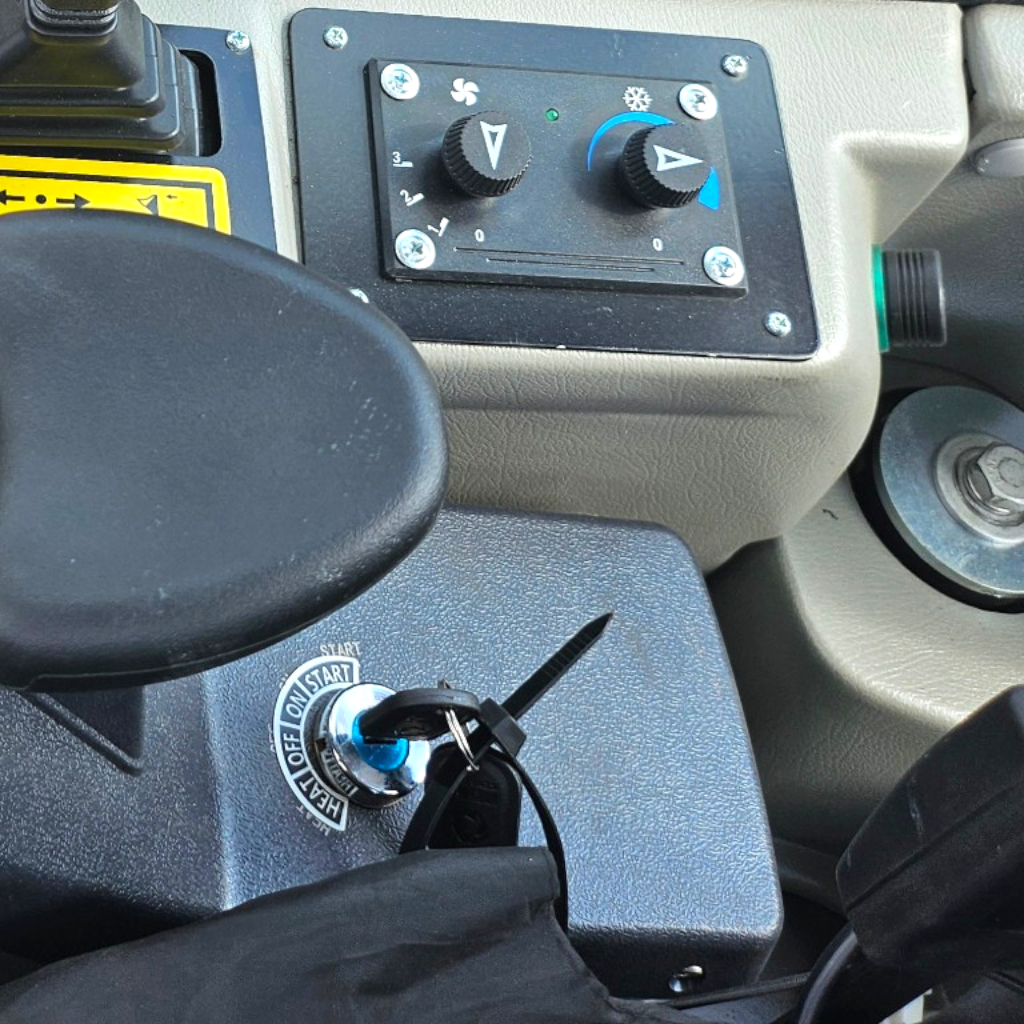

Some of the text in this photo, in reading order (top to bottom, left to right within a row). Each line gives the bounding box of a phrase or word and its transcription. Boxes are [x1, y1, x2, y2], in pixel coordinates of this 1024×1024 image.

[392, 151, 402, 164] 3
[399, 189, 413, 204] 2
[319, 640, 361, 657] START
[305, 663, 351, 692] START
[285, 688, 309, 719] ON
[283, 732, 305, 766] OFF
[298, 776, 342, 819] HEAT
